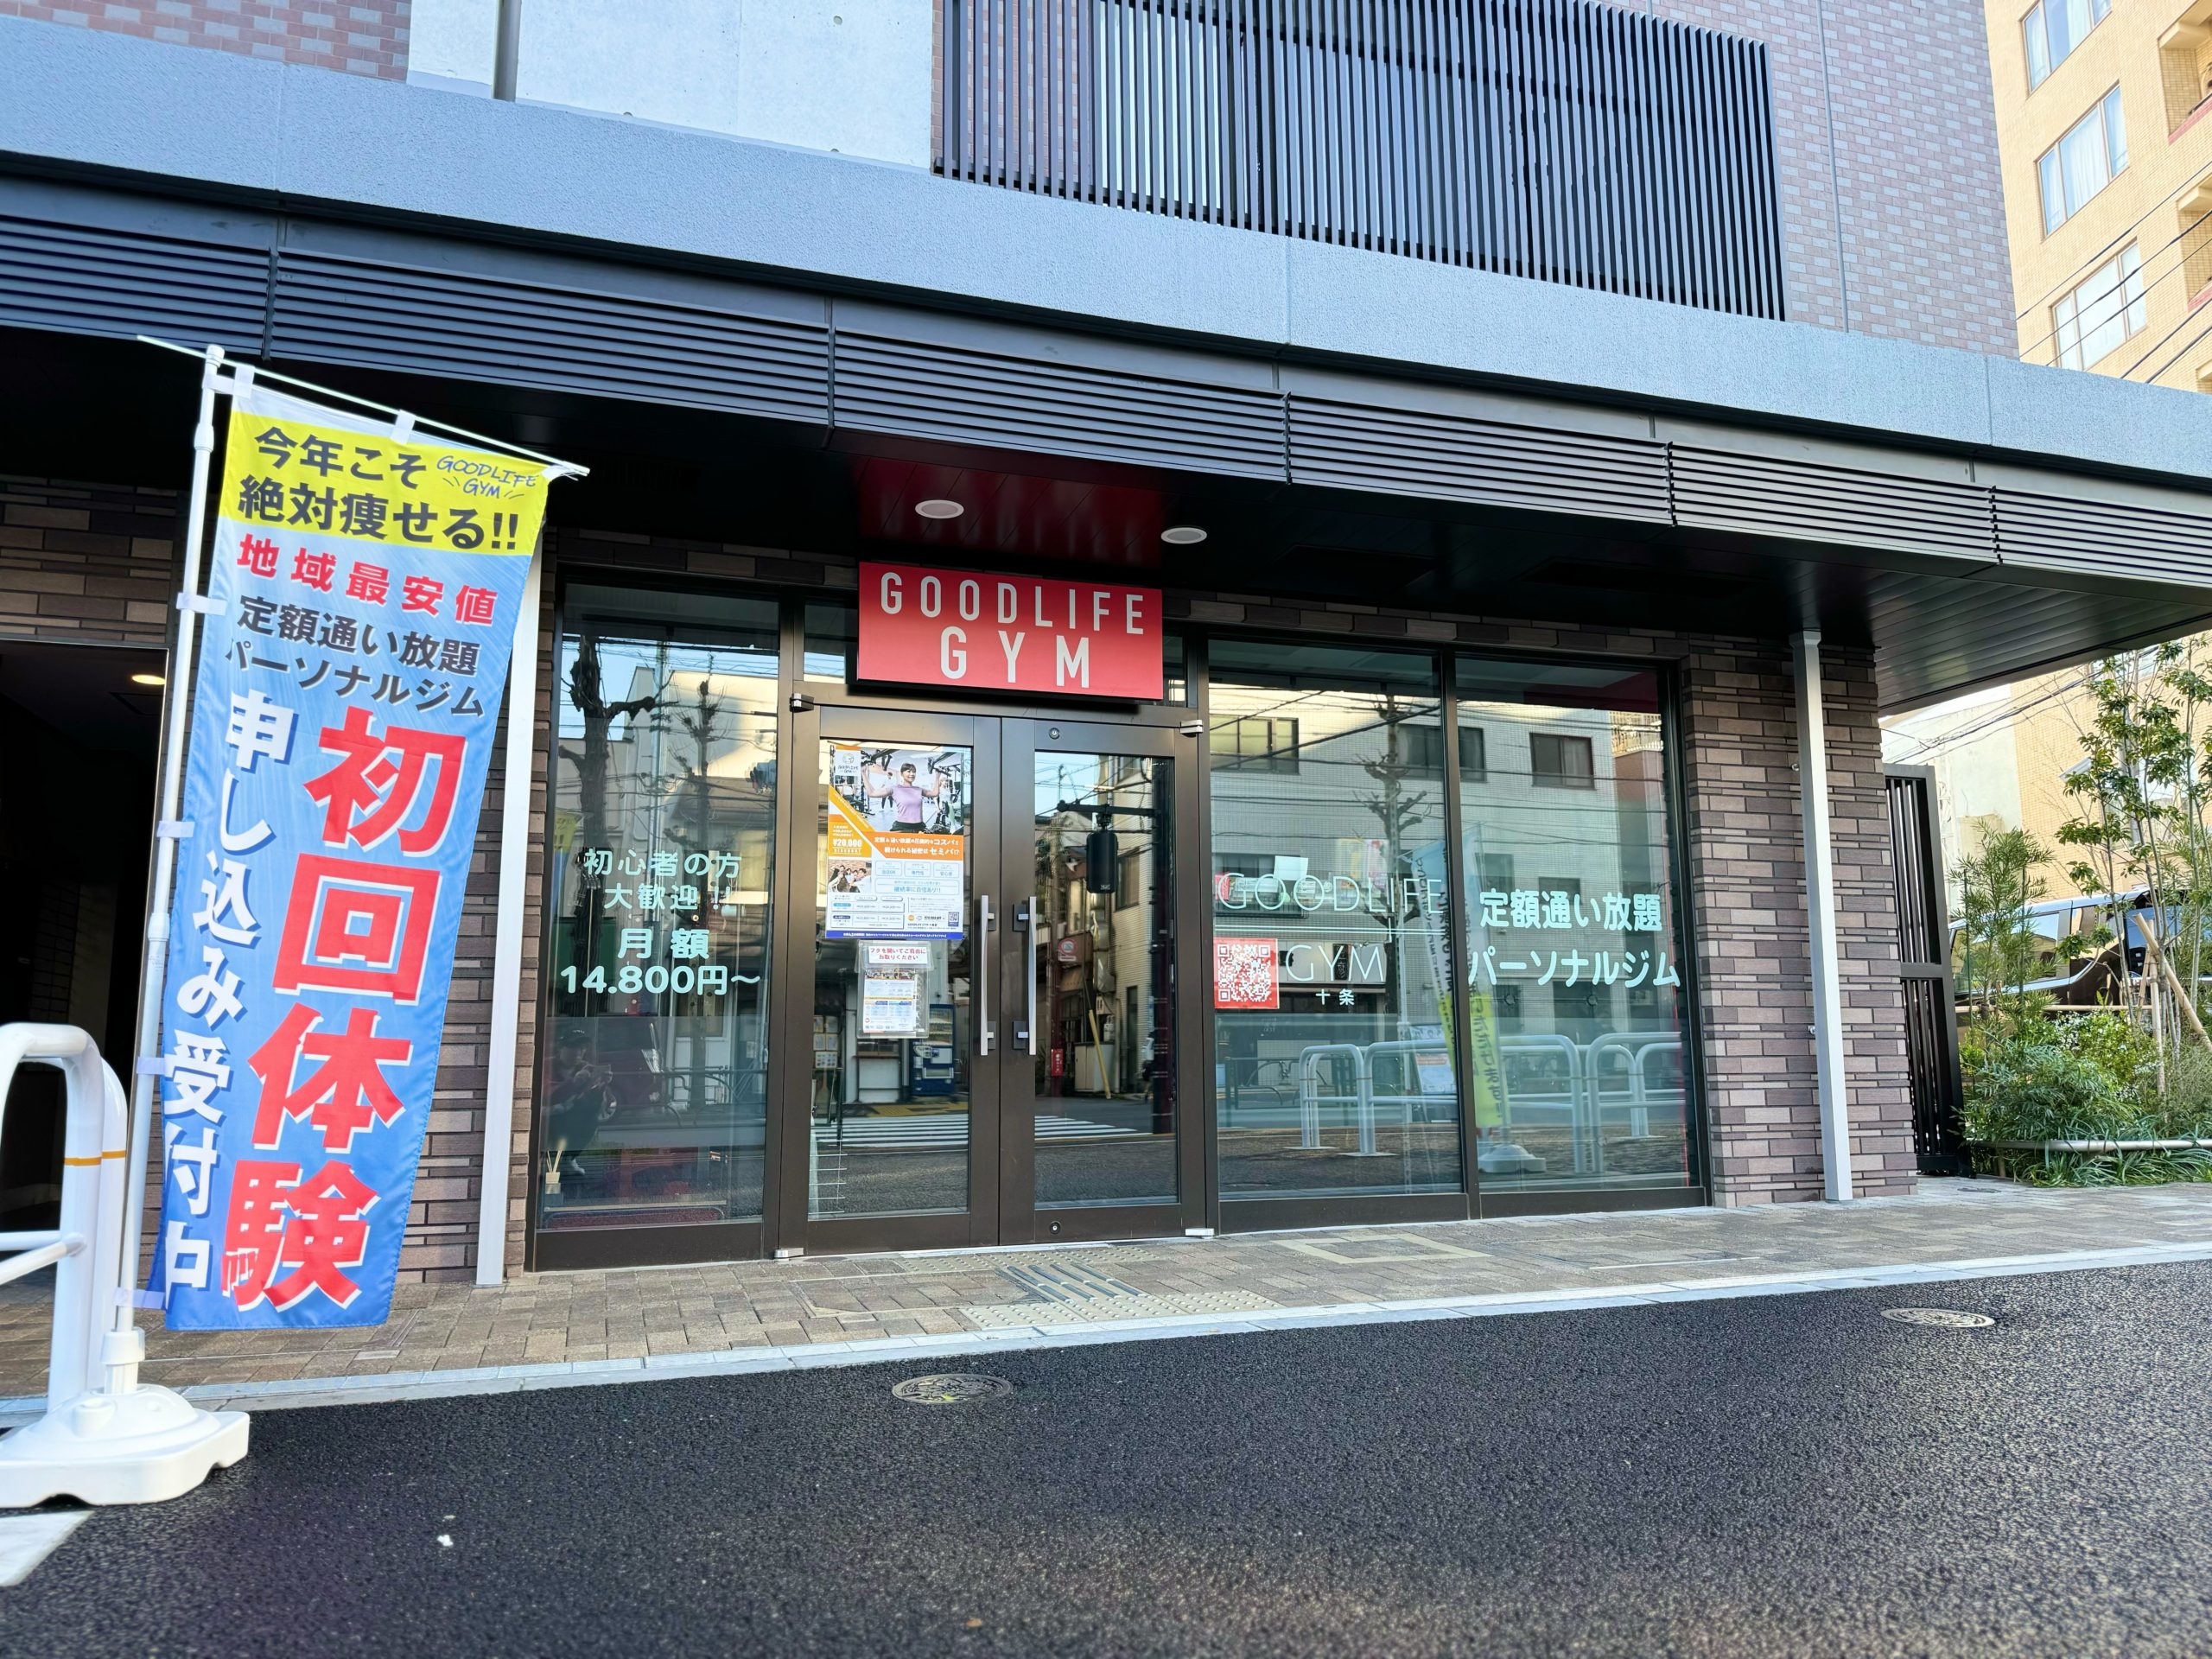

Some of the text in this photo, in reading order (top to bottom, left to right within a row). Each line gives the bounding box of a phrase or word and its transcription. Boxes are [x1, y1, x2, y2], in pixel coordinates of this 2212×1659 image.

[254, 426, 427, 490] 今年こそ
[436, 454, 537, 488] GOODLIFE
[463, 478, 502, 499] GYM
[238, 474, 518, 551] 絶対痩せる!!
[237, 534, 499, 627] 地域最安値
[880, 571, 1145, 635] GOODLIFE
[237, 594, 481, 677] 定額通い放題
[225, 638, 485, 719] パーソナルジム
[940, 626, 1090, 689] GYM
[584, 848, 742, 880] 初心者の方
[1217, 871, 1444, 914] GOODLIFE
[1479, 889, 1662, 932] 定額通い放題
[618, 928, 710, 959] 月額
[1286, 944, 1386, 983] GYM
[1469, 947, 1681, 988] パーソナルジム
[221, 705, 467, 1313] 初回体験
[1315, 988, 1356, 1007] 十条
